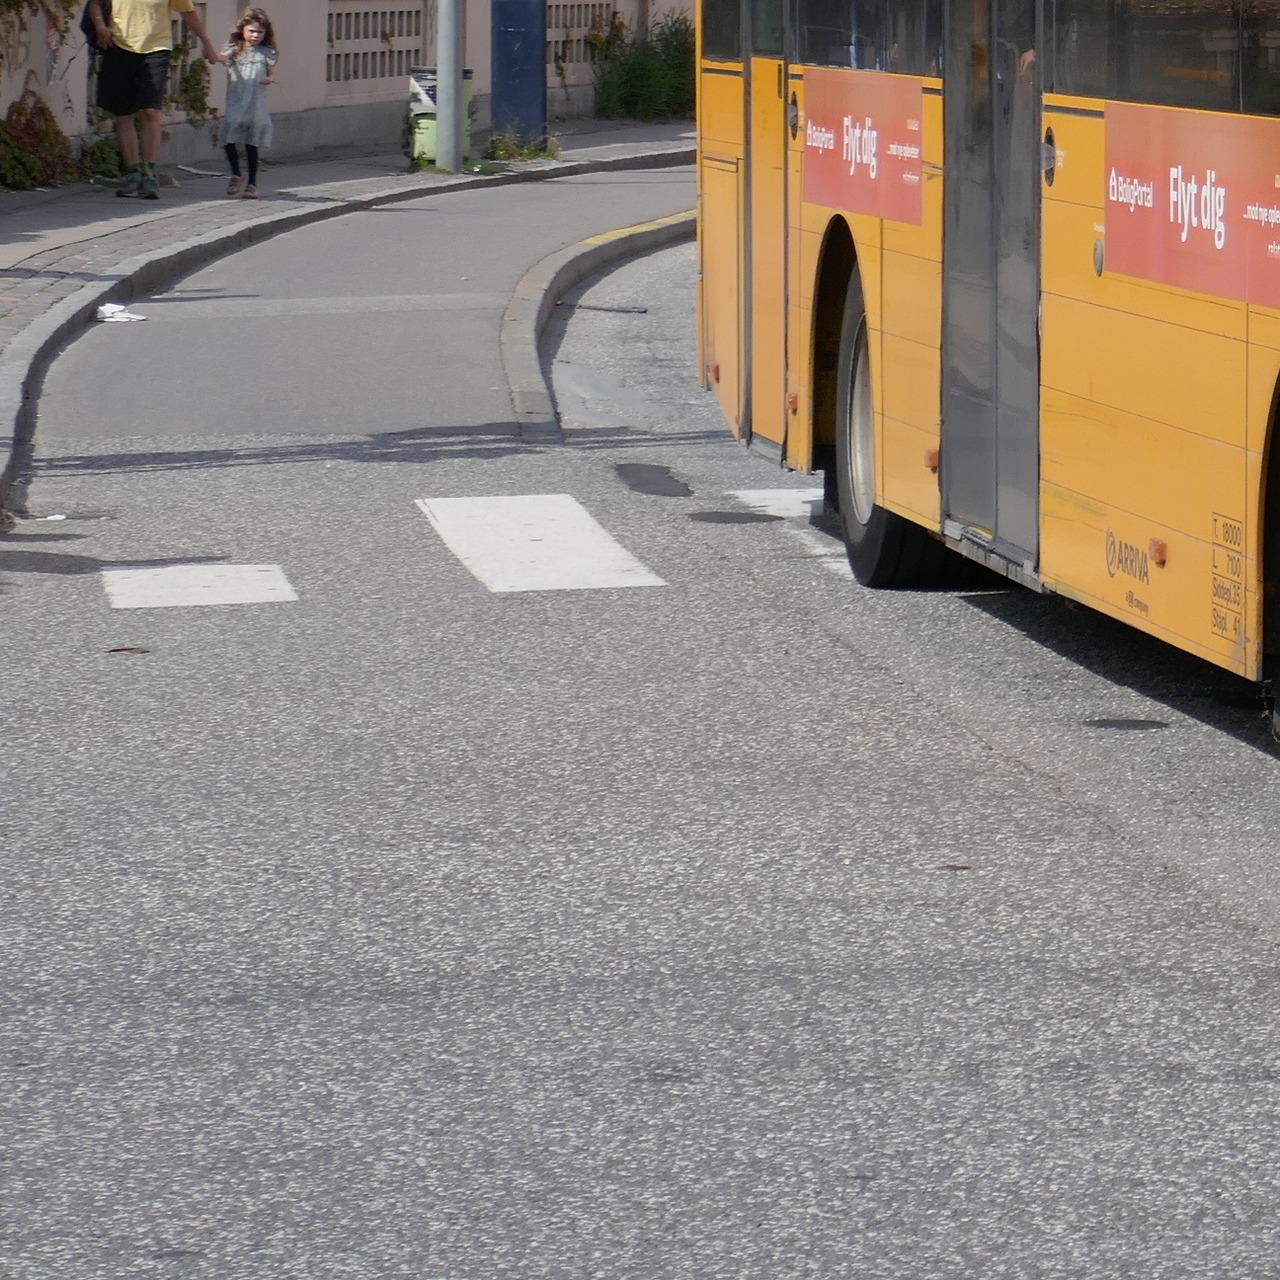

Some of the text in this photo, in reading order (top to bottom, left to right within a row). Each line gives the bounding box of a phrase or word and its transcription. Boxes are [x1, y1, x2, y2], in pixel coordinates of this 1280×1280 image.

[843, 115, 861, 176] Flyt
[862, 117, 877, 179] dig
[1118, 165, 1226, 250] BoligPortal Flyt dig
[1222, 522, 1241, 547] 18000
[1117, 540, 1149, 586] ARRIVA
